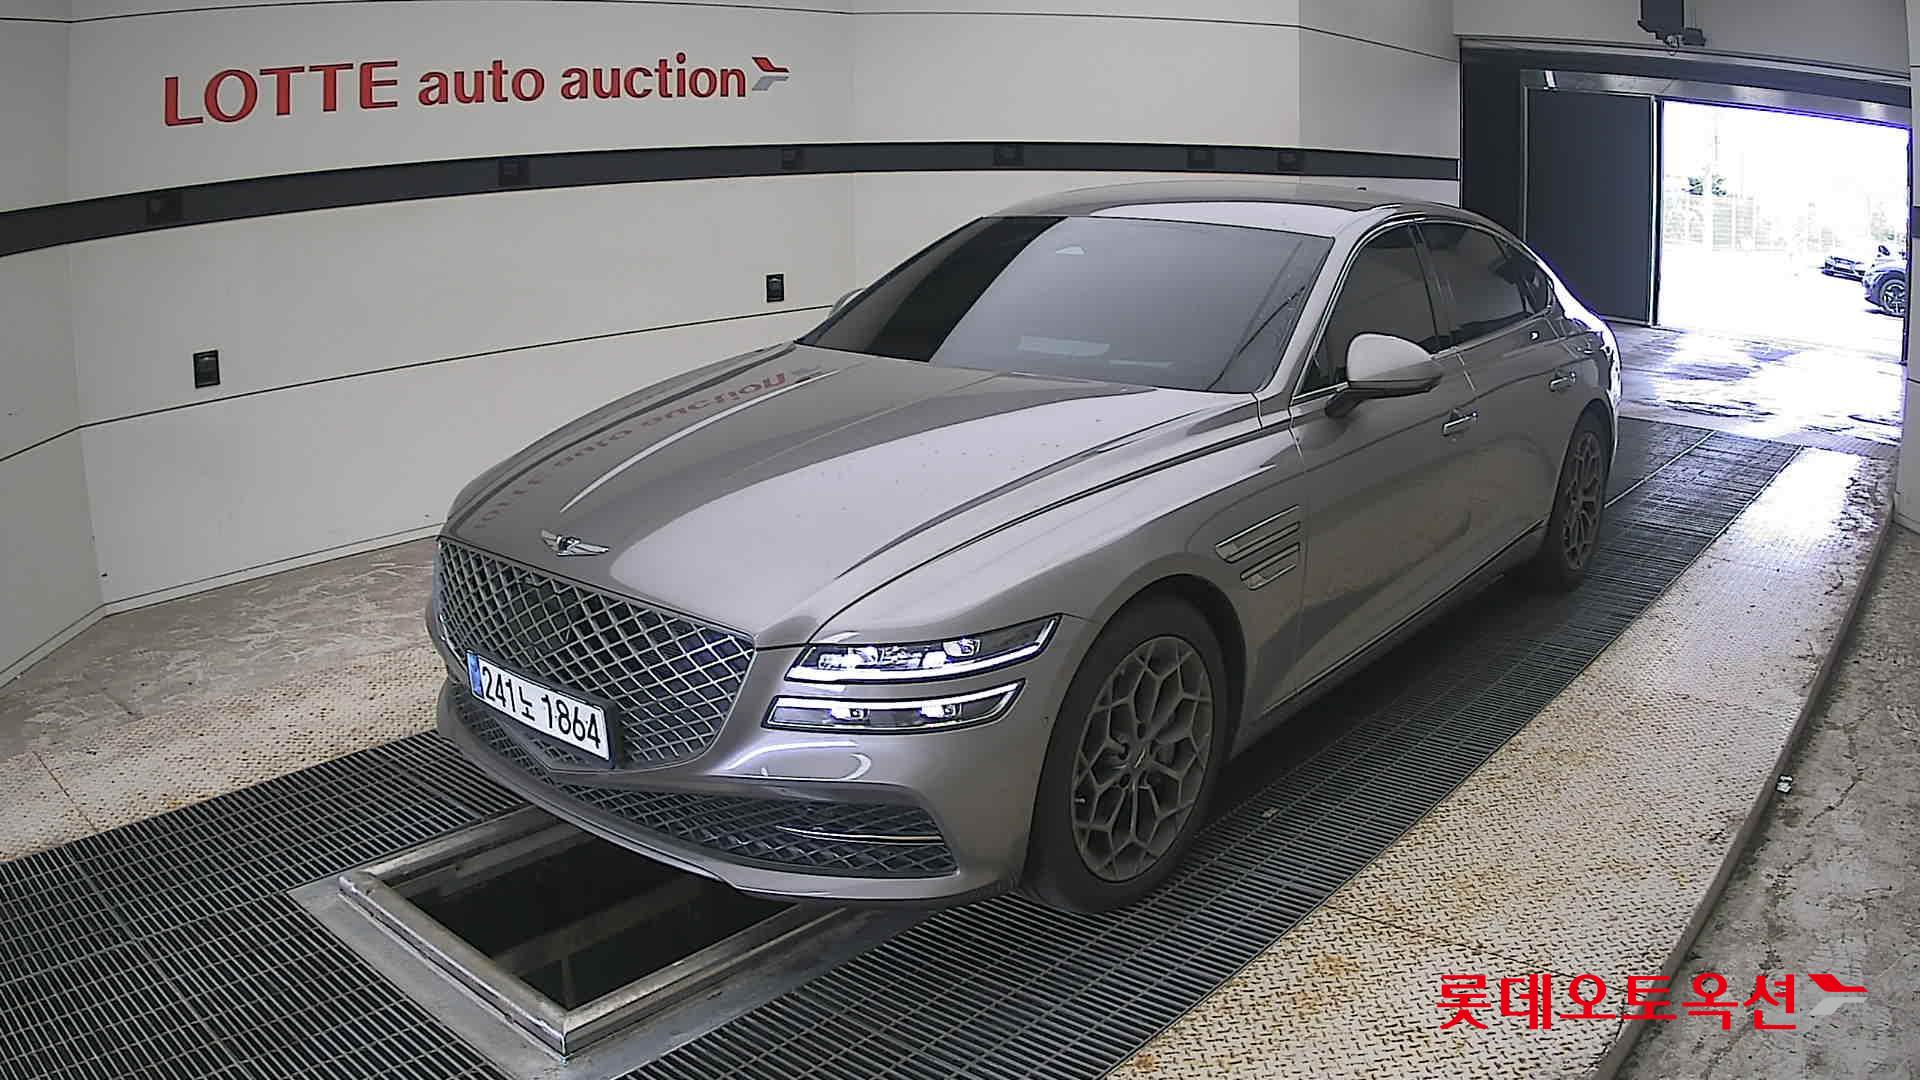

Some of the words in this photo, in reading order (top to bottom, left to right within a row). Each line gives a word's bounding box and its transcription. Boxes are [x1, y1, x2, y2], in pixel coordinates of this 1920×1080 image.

[164, 61, 398, 127] LOTTE
[417, 59, 545, 106] auto
[560, 53, 747, 100] auction
[541, 694, 600, 749] 1864
